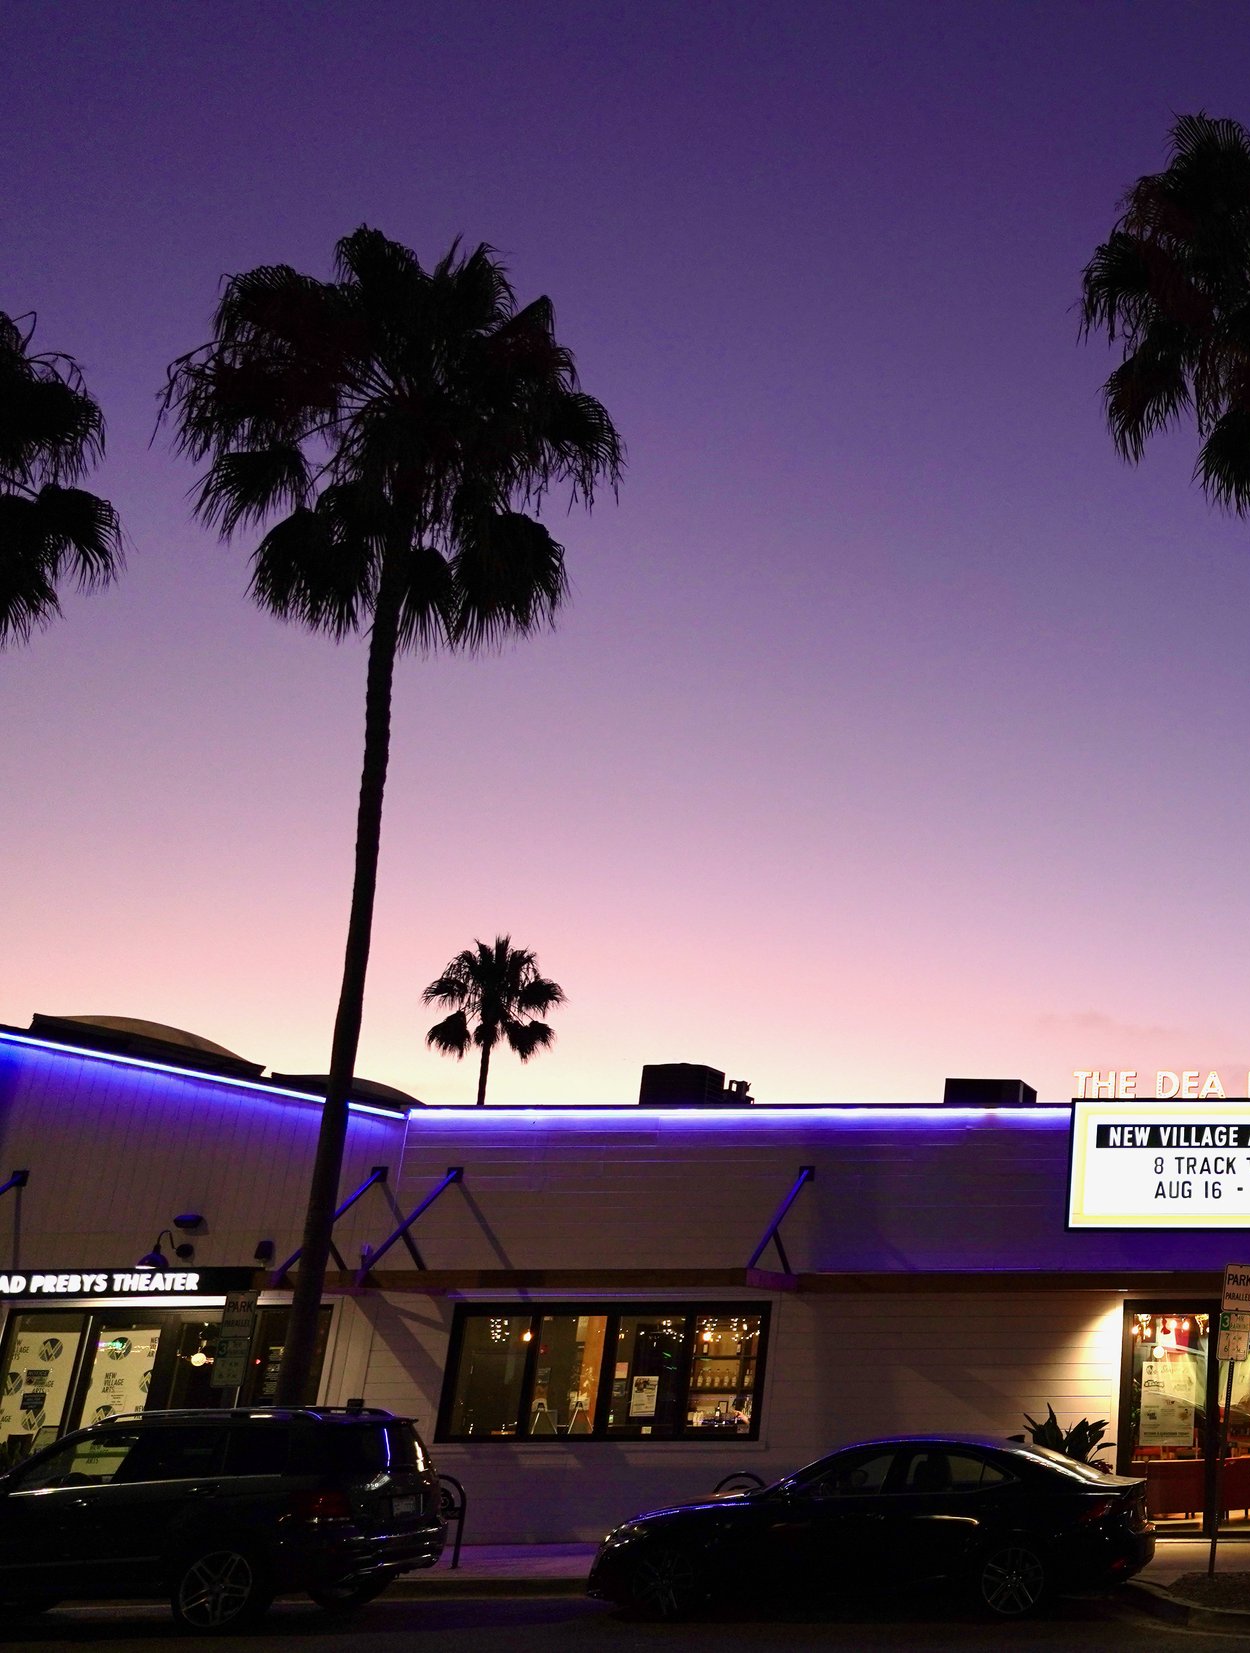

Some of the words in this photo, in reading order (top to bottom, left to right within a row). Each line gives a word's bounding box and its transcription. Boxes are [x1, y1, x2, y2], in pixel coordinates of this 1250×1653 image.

[1073, 1071, 1137, 1098] THE
[1155, 1071, 1226, 1098] DEA
[1109, 1126, 1150, 1147] NEW
[1159, 1126, 1239, 1147] VILLAGE
[1154, 1157, 1164, 1175] 8
[1174, 1157, 1237, 1175] TRACK
[1154, 1181, 1193, 1199] AUG
[1204, 1181, 1222, 1199] 16
[29, 1274, 108, 1293] PREBYS
[113, 1272, 199, 1291] THEATER
[1225, 1292, 1250, 1301] PARALLEL
[226, 1301, 254, 1312] PARK
[1222, 1316, 1230, 1329] 3
